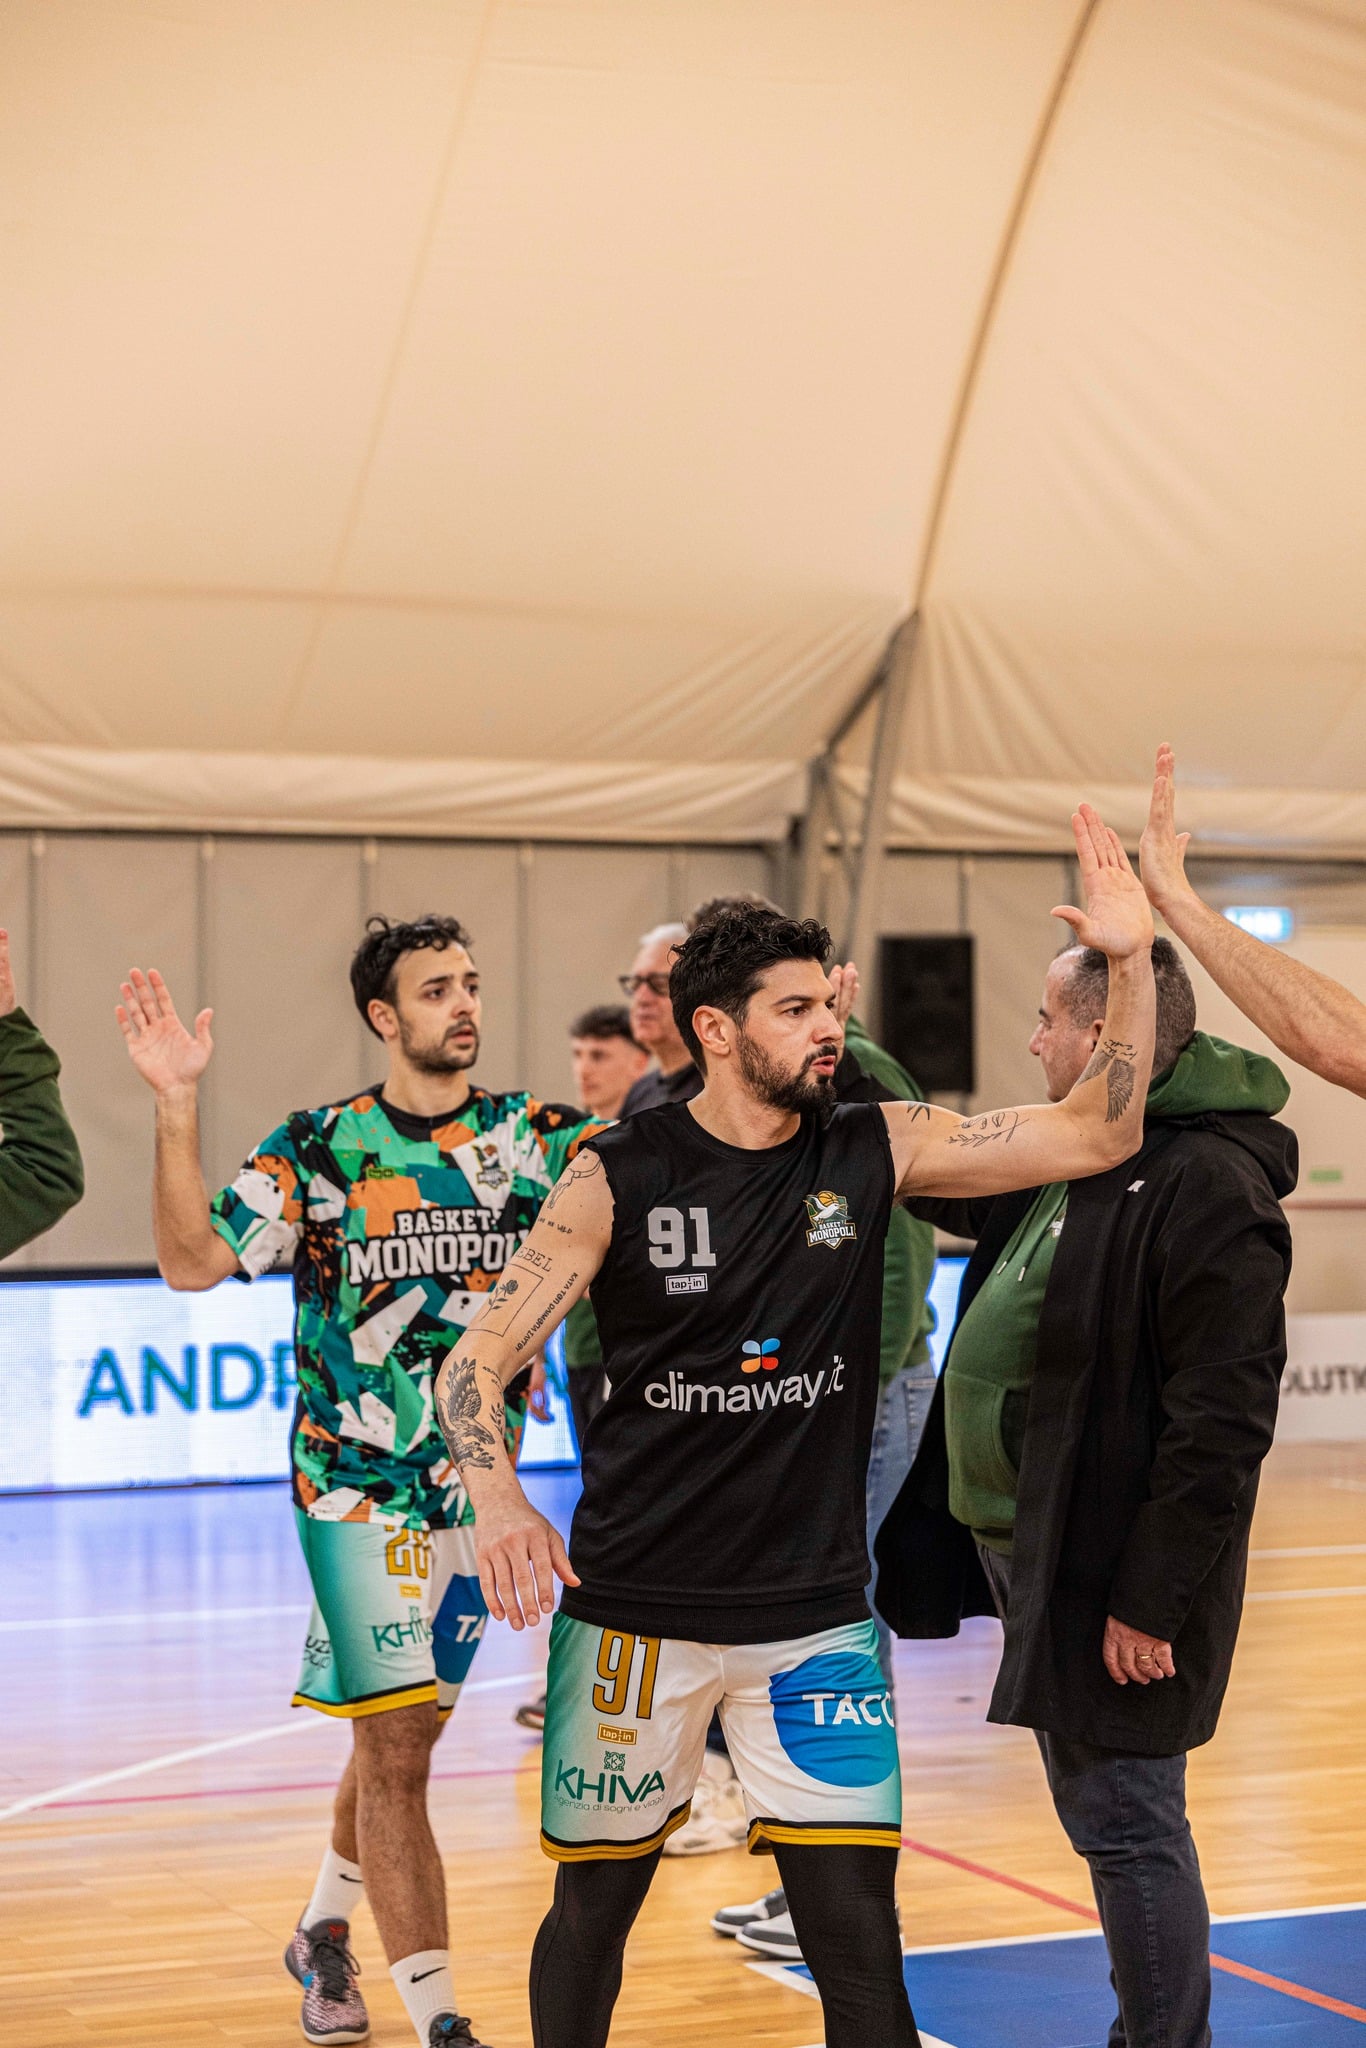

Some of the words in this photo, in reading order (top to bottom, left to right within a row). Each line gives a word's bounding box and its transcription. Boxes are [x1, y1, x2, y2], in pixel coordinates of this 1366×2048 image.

[396, 1209, 494, 1236] BASKET
[808, 1226, 854, 1244] MONOPOLI
[647, 1207, 717, 1269] 91
[671, 1278, 702, 1290] tap-in
[592, 1628, 661, 1719] 91
[555, 1759, 665, 1804] KHIVA
[592, 1803, 603, 1811] di
[603, 1804, 632, 1814] sogni
